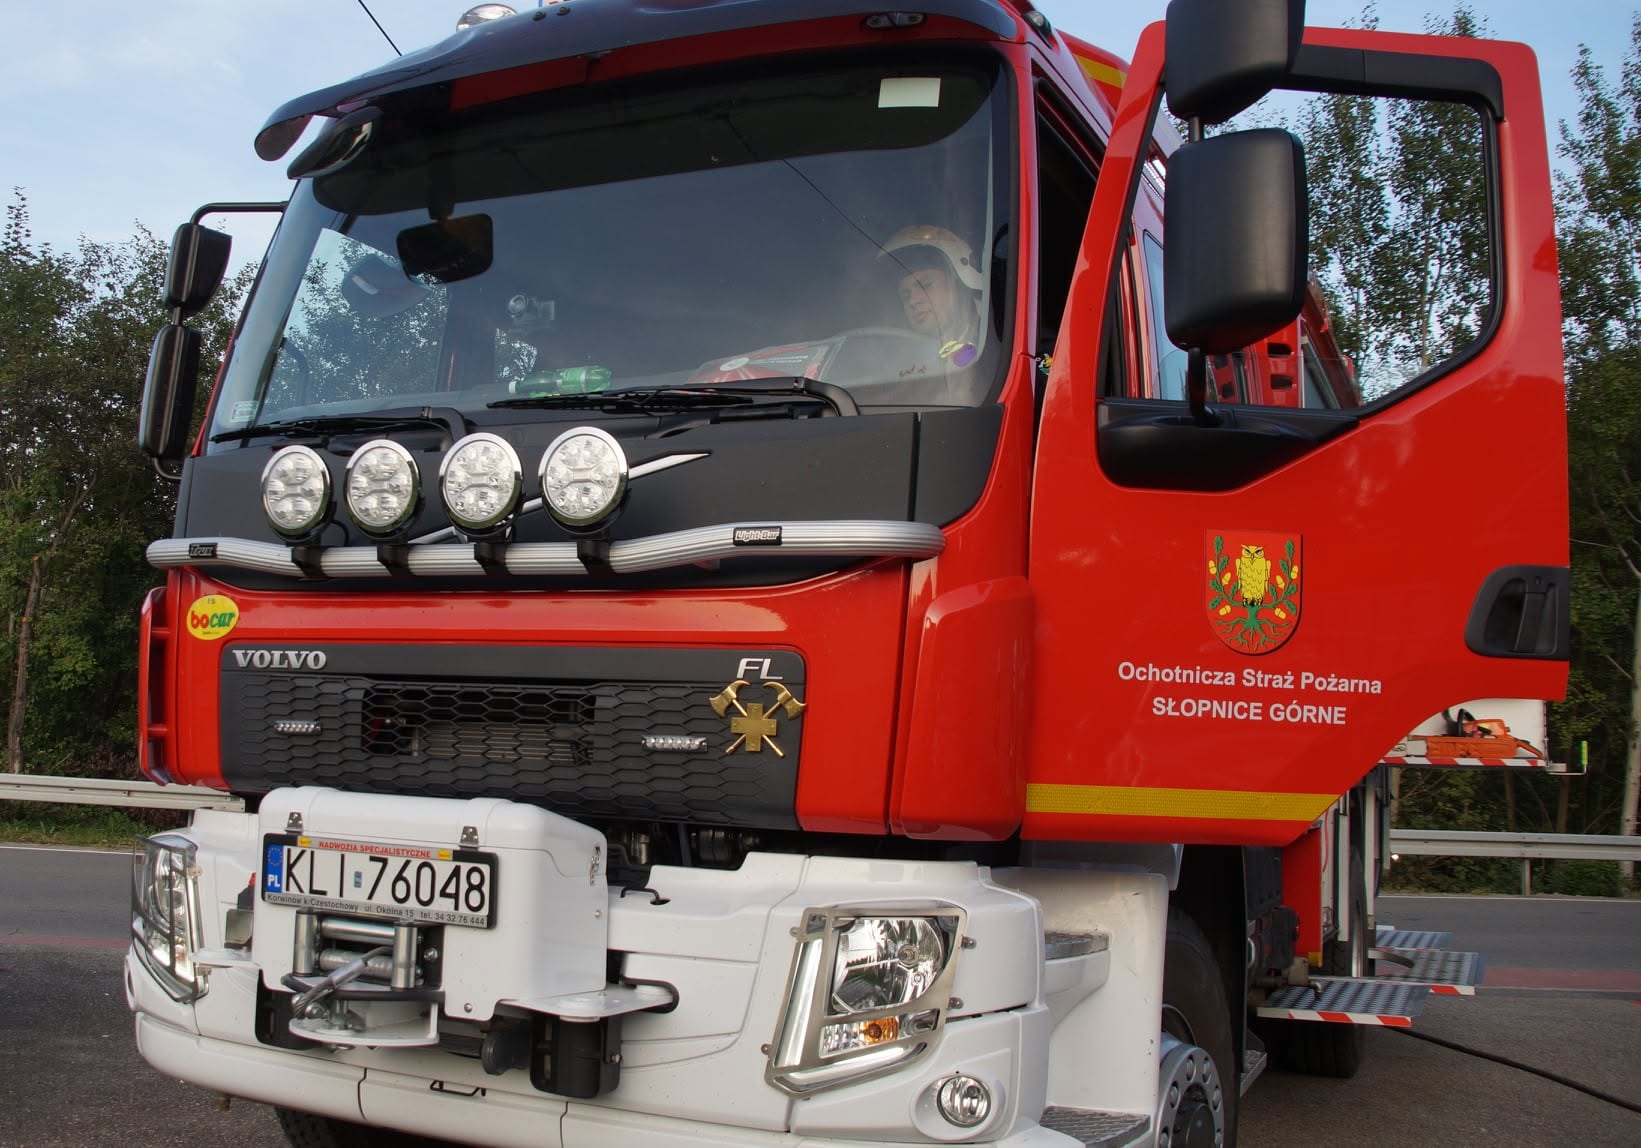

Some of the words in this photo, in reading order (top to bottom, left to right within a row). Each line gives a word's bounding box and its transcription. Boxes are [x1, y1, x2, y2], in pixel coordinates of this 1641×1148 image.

[191, 610, 236, 629] bocar
[232, 649, 327, 670] VOLVO
[736, 658, 783, 680] FL
[1118, 661, 1236, 686] Ochotnicza
[1242, 668, 1295, 689] Straż
[1301, 672, 1382, 694] Pożarna
[1152, 697, 1262, 721] SŁOPNICE
[1269, 700, 1347, 725] GÓRNE
[319, 841, 358, 852] NADWOZIA
[360, 844, 431, 858] SPECJALISTYCZNE
[267, 874, 281, 887] PL
[367, 855, 485, 912] 76048
[406, 909, 414, 918] 15
[420, 911, 432, 920] tel.
